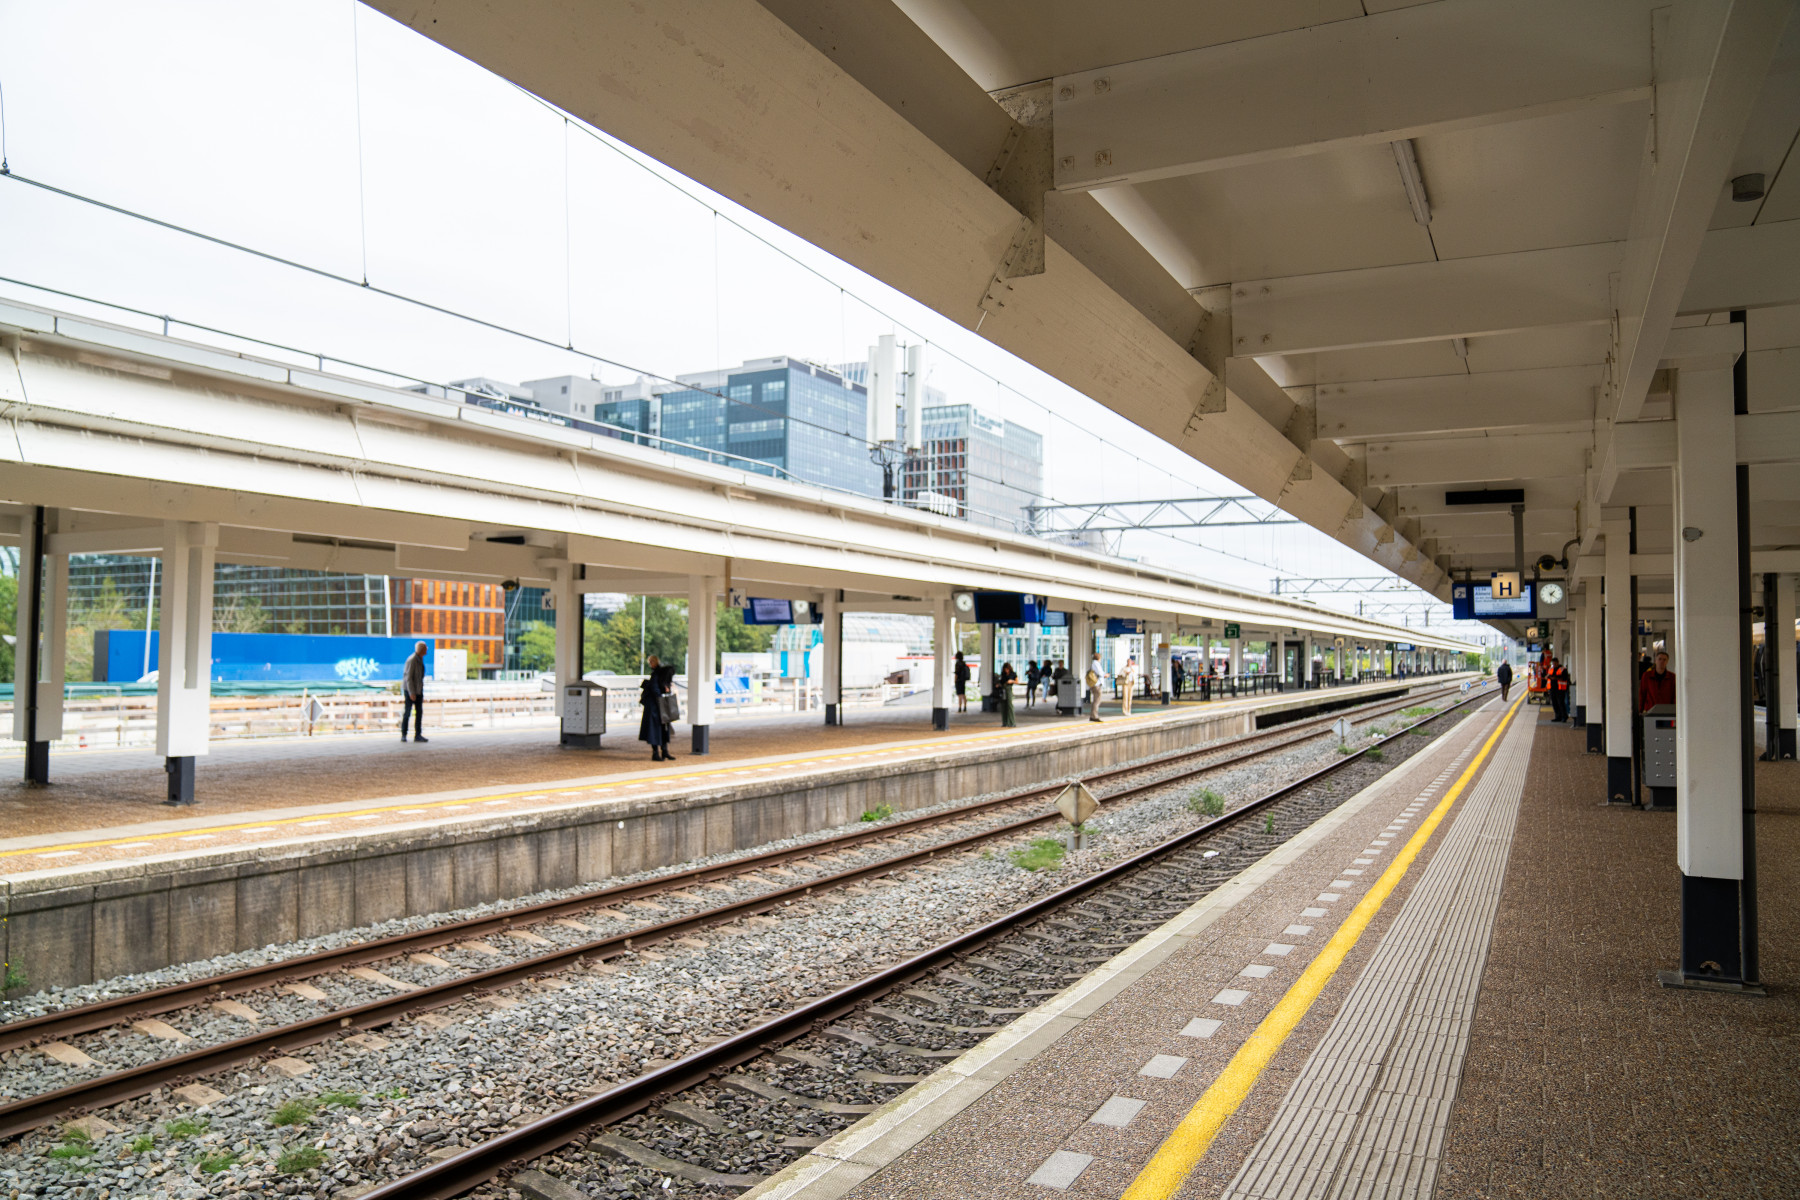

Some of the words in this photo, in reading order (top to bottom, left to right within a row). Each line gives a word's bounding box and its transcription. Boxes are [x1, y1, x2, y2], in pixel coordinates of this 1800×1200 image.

[1499, 581, 1512, 596] H
[545, 598, 552, 608] K
[733, 594, 741, 606] K
